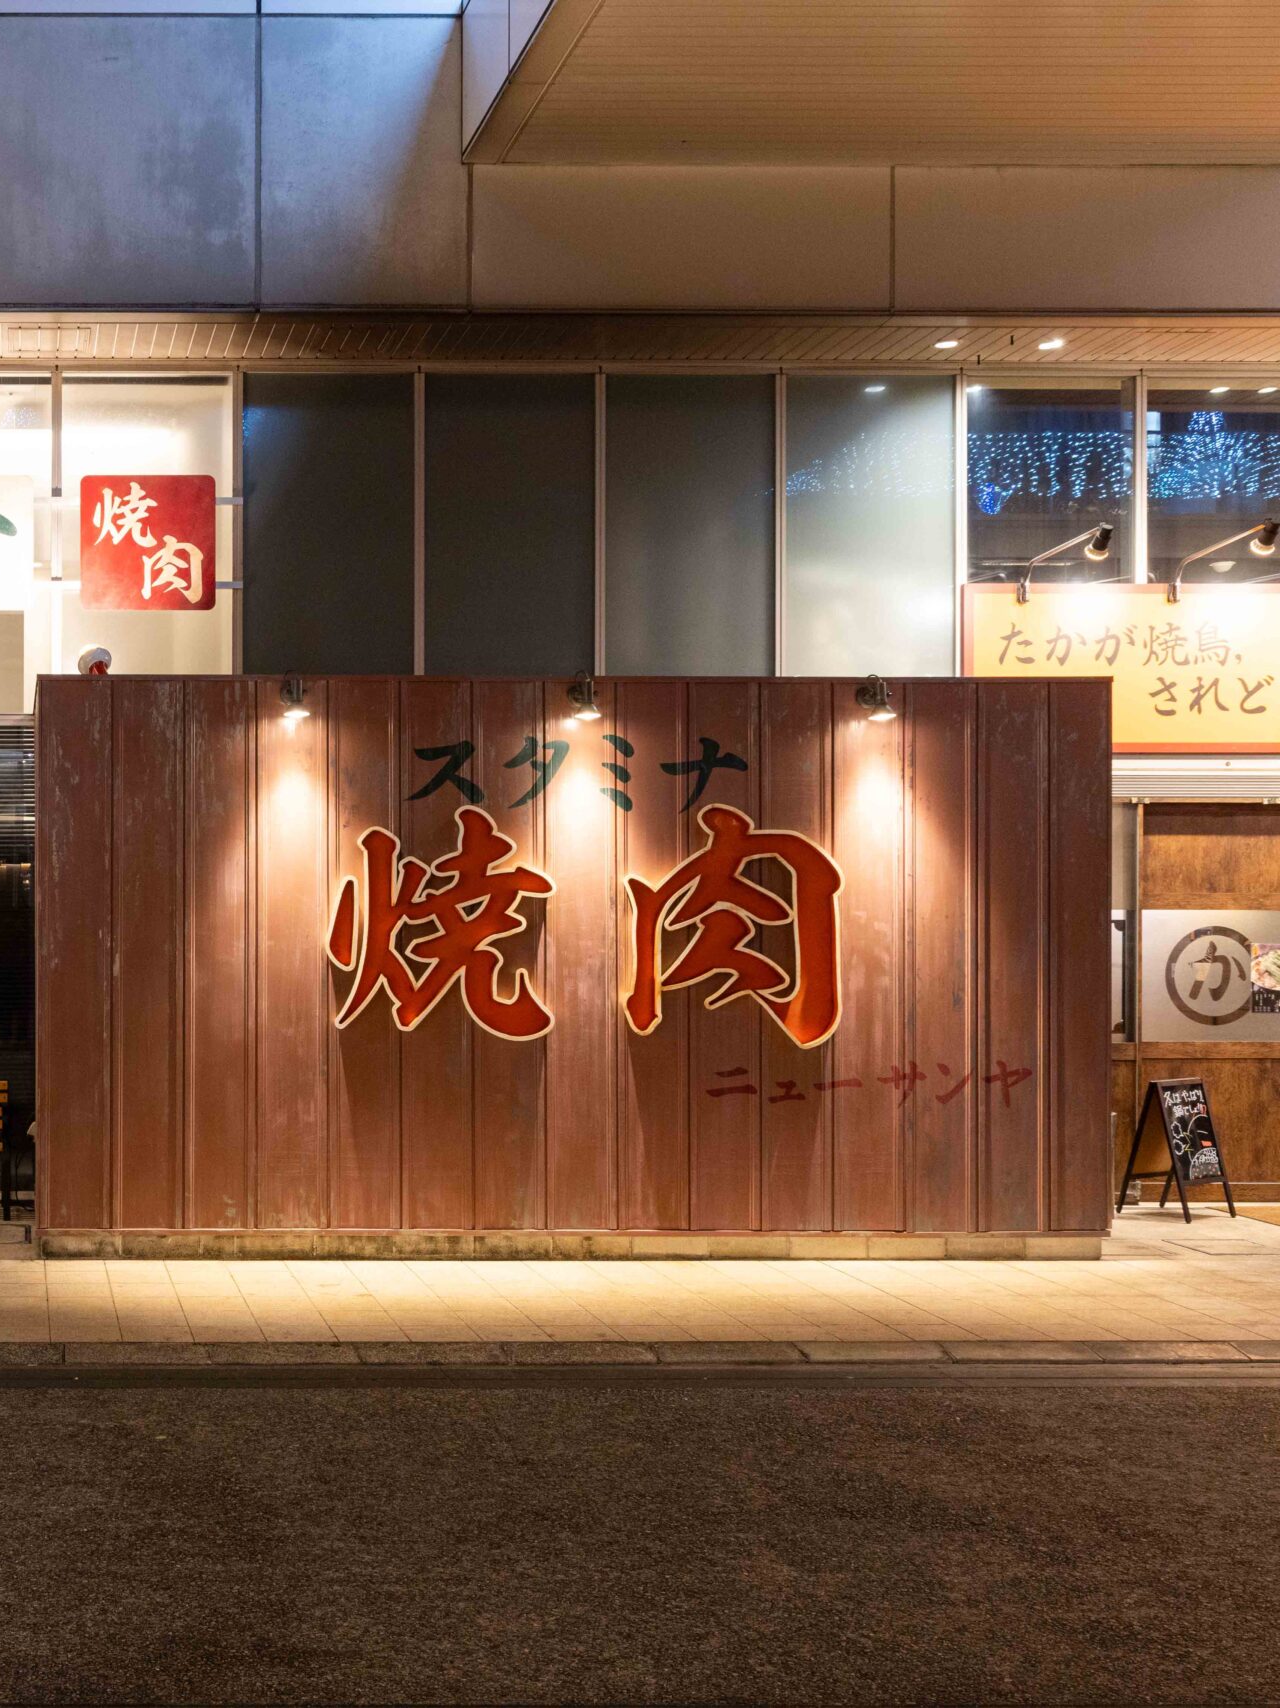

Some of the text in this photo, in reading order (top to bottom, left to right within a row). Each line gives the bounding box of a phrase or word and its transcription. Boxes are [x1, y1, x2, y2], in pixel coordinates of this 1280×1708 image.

[1148, 675, 1275, 717] されど
[406, 733, 749, 813] スタミナ
[328, 803, 845, 1048] 焼肉
[705, 1060, 1033, 1108] ニューサンヤ
